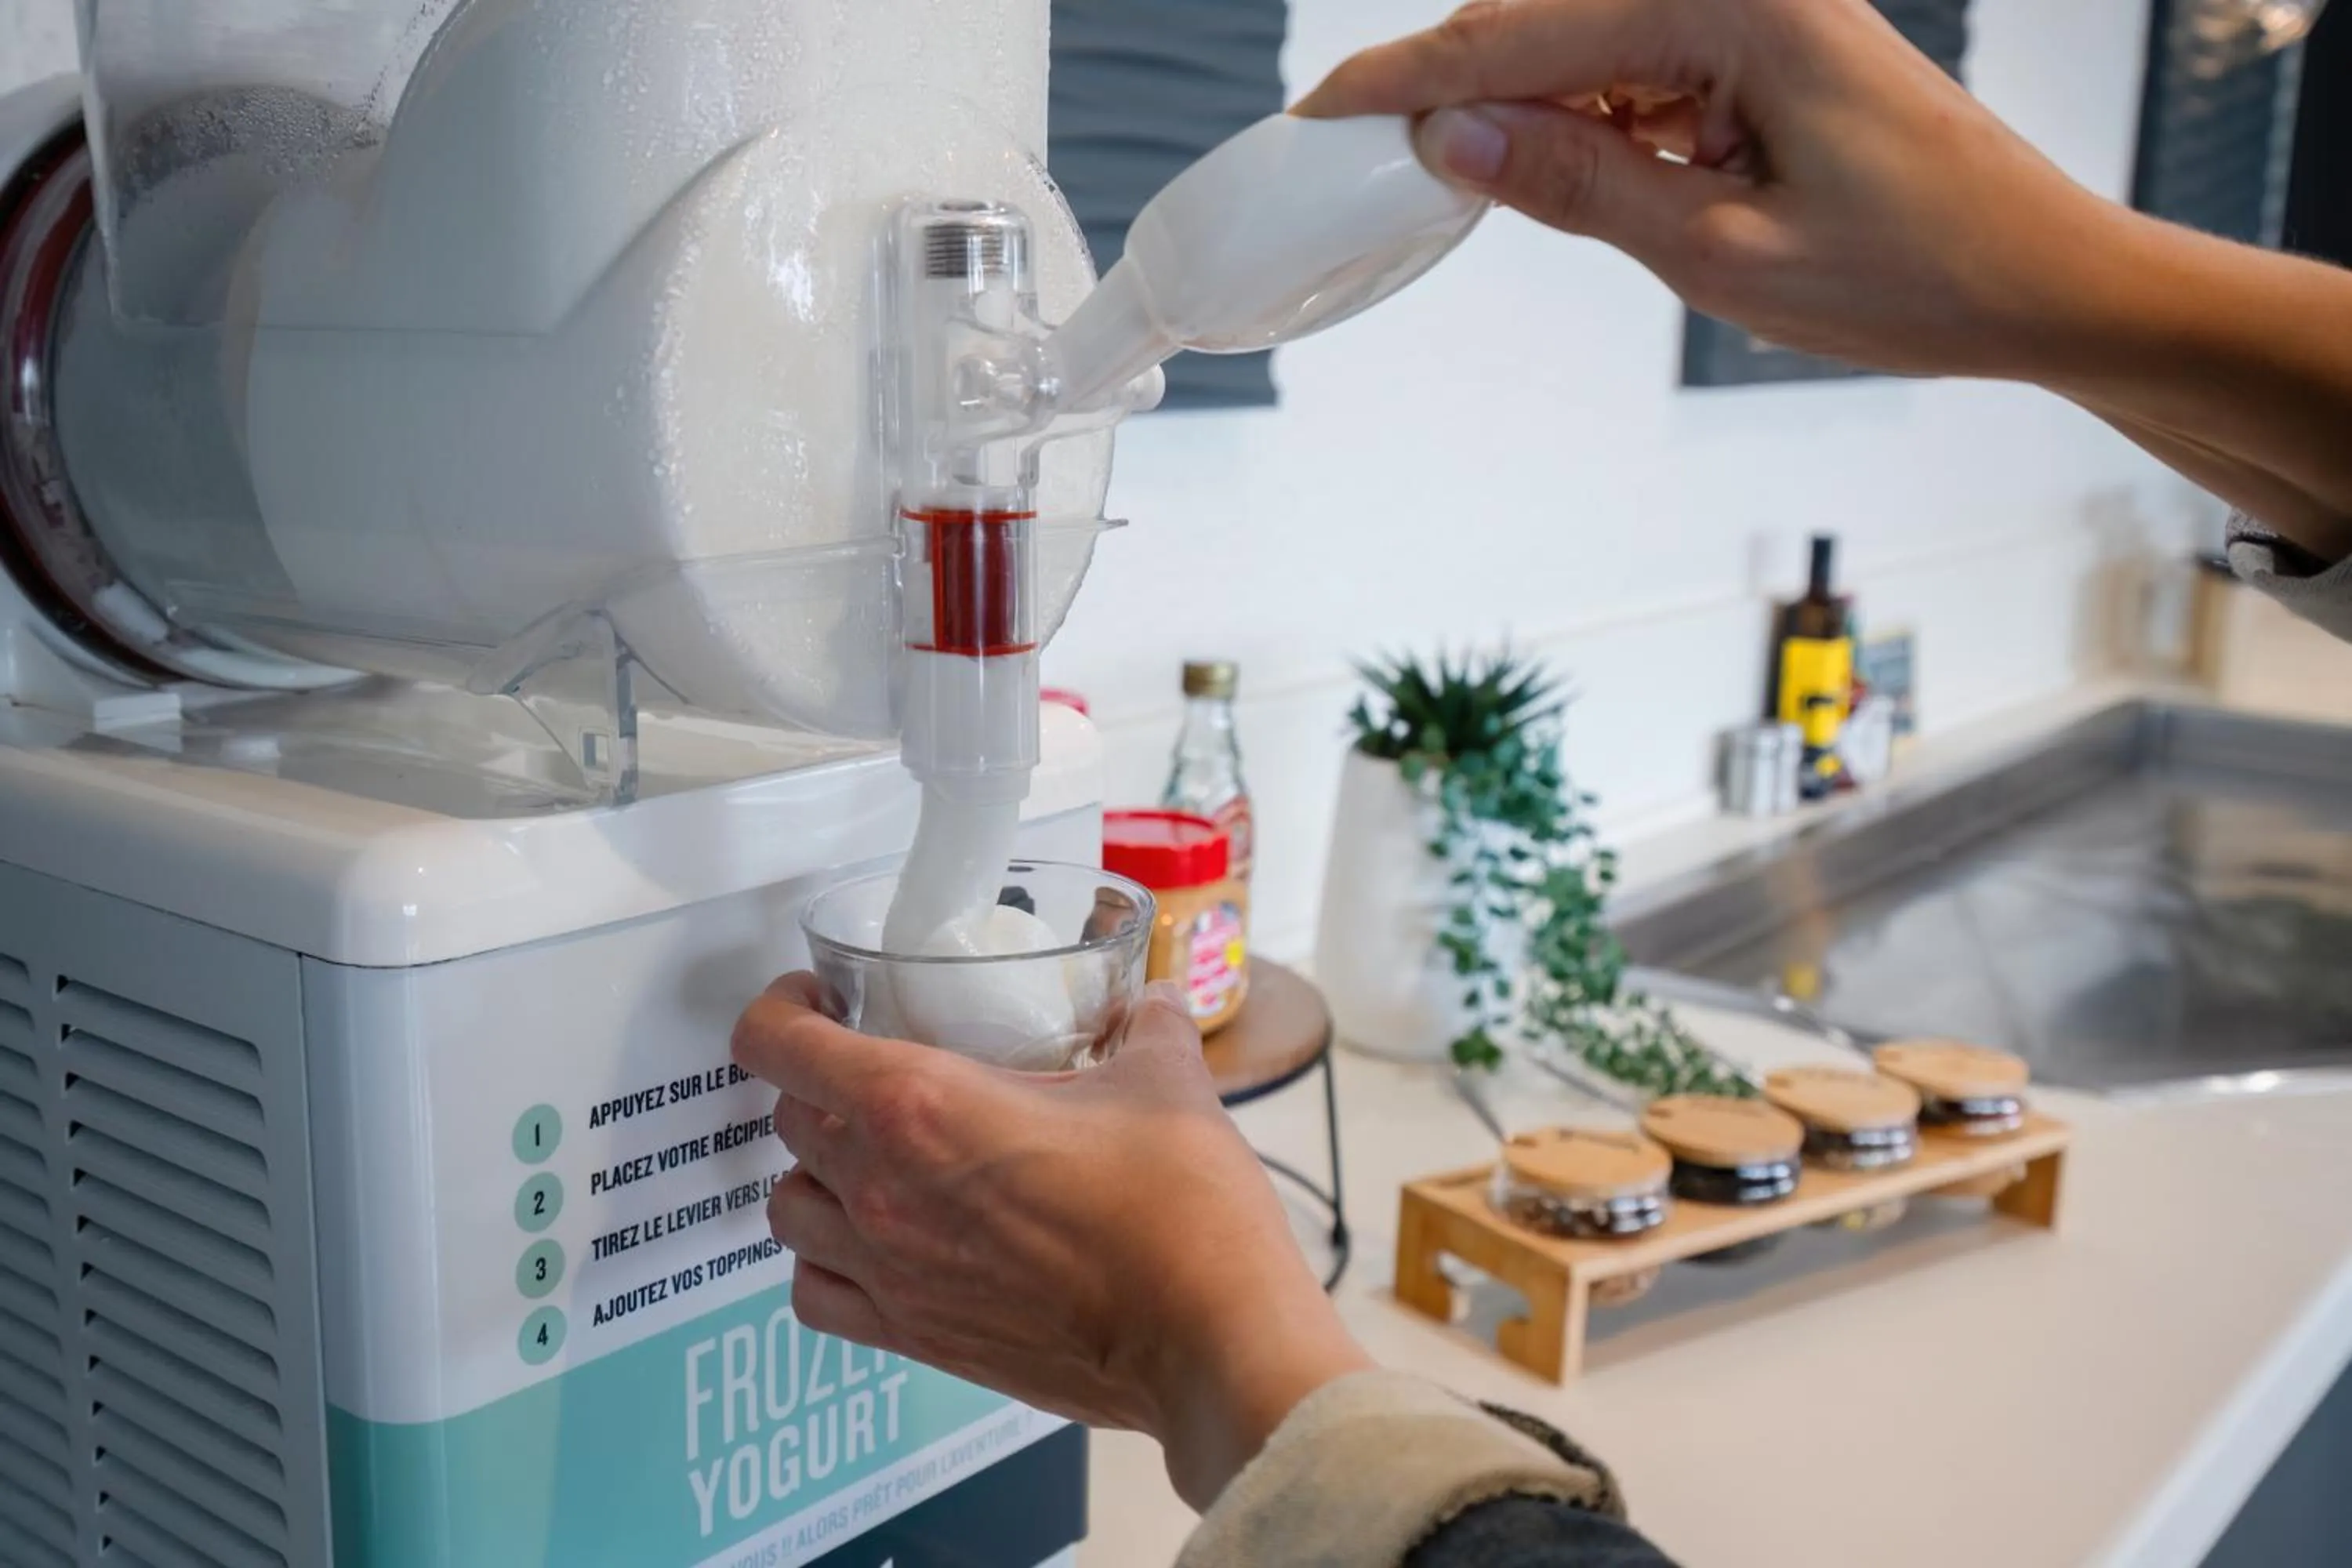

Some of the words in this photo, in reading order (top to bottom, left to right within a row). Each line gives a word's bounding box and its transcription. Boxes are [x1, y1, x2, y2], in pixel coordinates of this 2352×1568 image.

[589, 1084, 666, 1130] APPUYEZ
[669, 1073, 703, 1105] SUR
[706, 1066, 725, 1092] LE
[533, 1191, 546, 1215] 2
[590, 1153, 654, 1196] PLACEZ
[657, 1134, 710, 1172] VOTRE
[713, 1113, 778, 1154] RÉCIPIE
[535, 1257, 546, 1281] 3
[591, 1223, 641, 1261] TIREZ
[644, 1215, 663, 1243] LE
[667, 1194, 722, 1234] LEVIER
[724, 1179, 760, 1212] VERS
[536, 1323, 550, 1346] 4
[592, 1277, 669, 1327] AJOUTEZ
[671, 1264, 703, 1295] VOS
[706, 1236, 783, 1281] TOPPINGS
[685, 1305, 906, 1462] FROZ
[687, 1369, 909, 1539] YOGURT
[796, 1506, 850, 1550] ALORS
[895, 1459, 937, 1498] POUR
